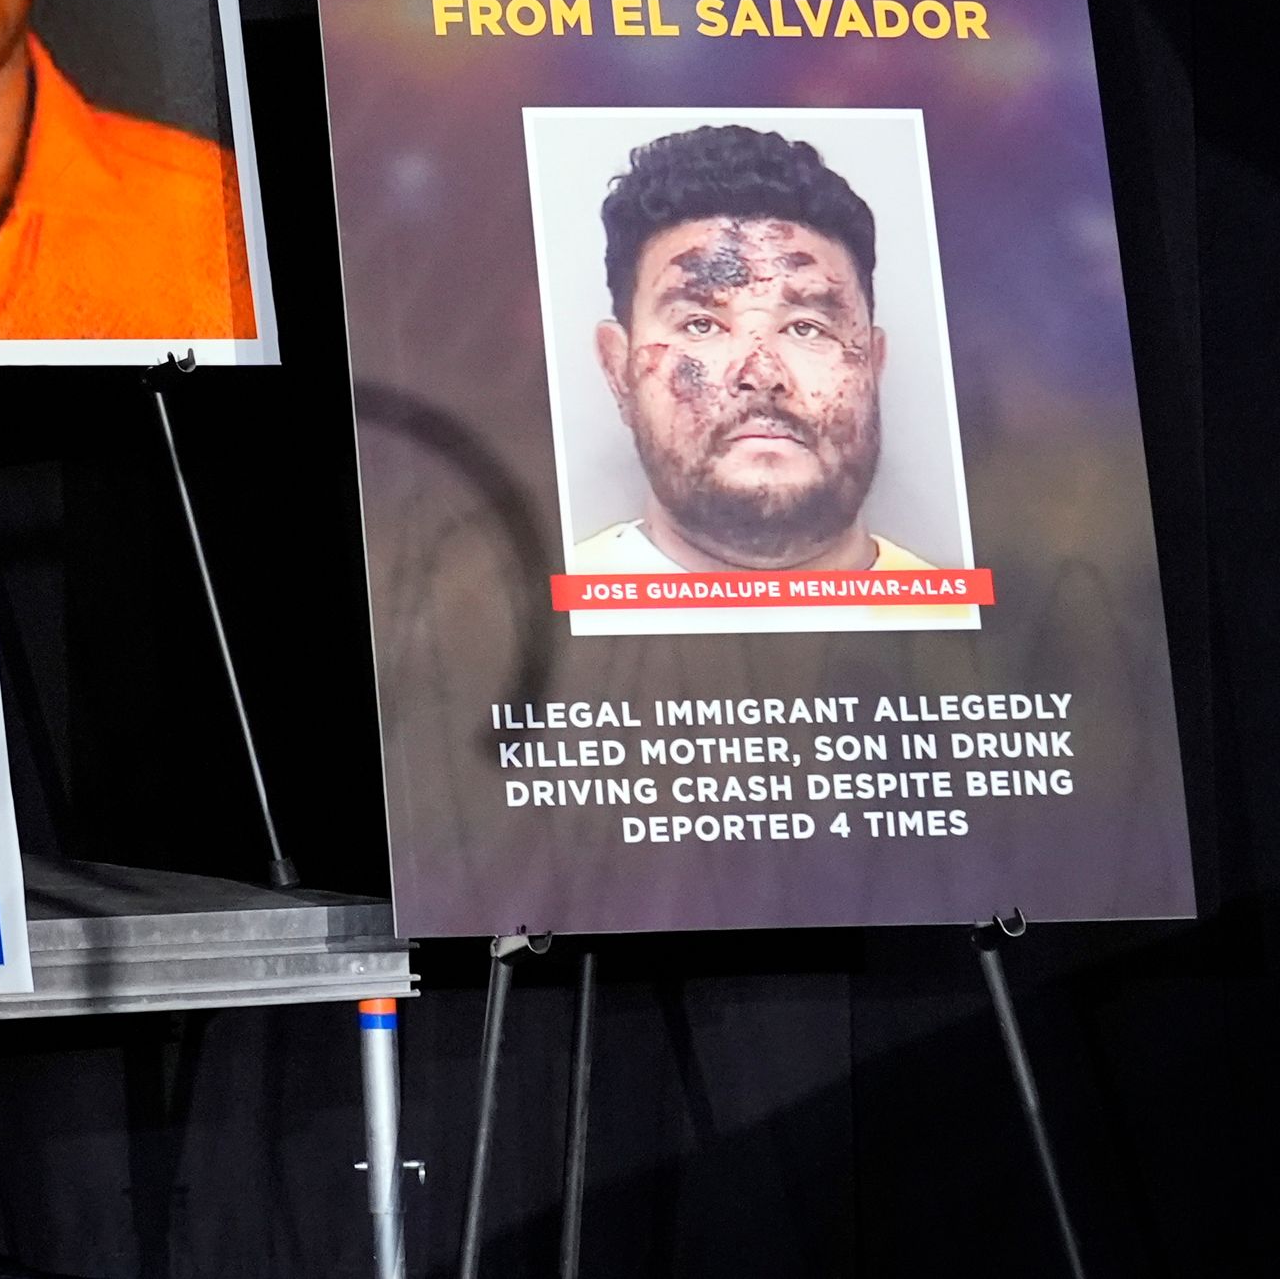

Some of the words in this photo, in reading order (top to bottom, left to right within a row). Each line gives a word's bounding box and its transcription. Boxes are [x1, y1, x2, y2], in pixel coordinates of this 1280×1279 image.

[581, 583, 639, 601] JOSE
[646, 581, 781, 600] GUADALUPE
[789, 578, 967, 597] MENJIVAR-ALAS
[491, 701, 642, 730] ILLEGAL
[654, 696, 859, 726] IMMIGRANT
[873, 693, 1072, 722] ALLEGEDLY
[499, 740, 626, 768] KILLED
[640, 736, 801, 767] MOTHER,
[814, 734, 887, 762] SON
[901, 733, 937, 760] IN
[951, 731, 1074, 759] DRUNK
[505, 777, 658, 807] DRIVING
[671, 775, 793, 804] CRASH
[807, 771, 953, 801] DESPITE
[965, 769, 1074, 797] BEING
[622, 813, 816, 843] DEPORTED
[829, 812, 851, 838] 4
[863, 809, 969, 838] TIMES
